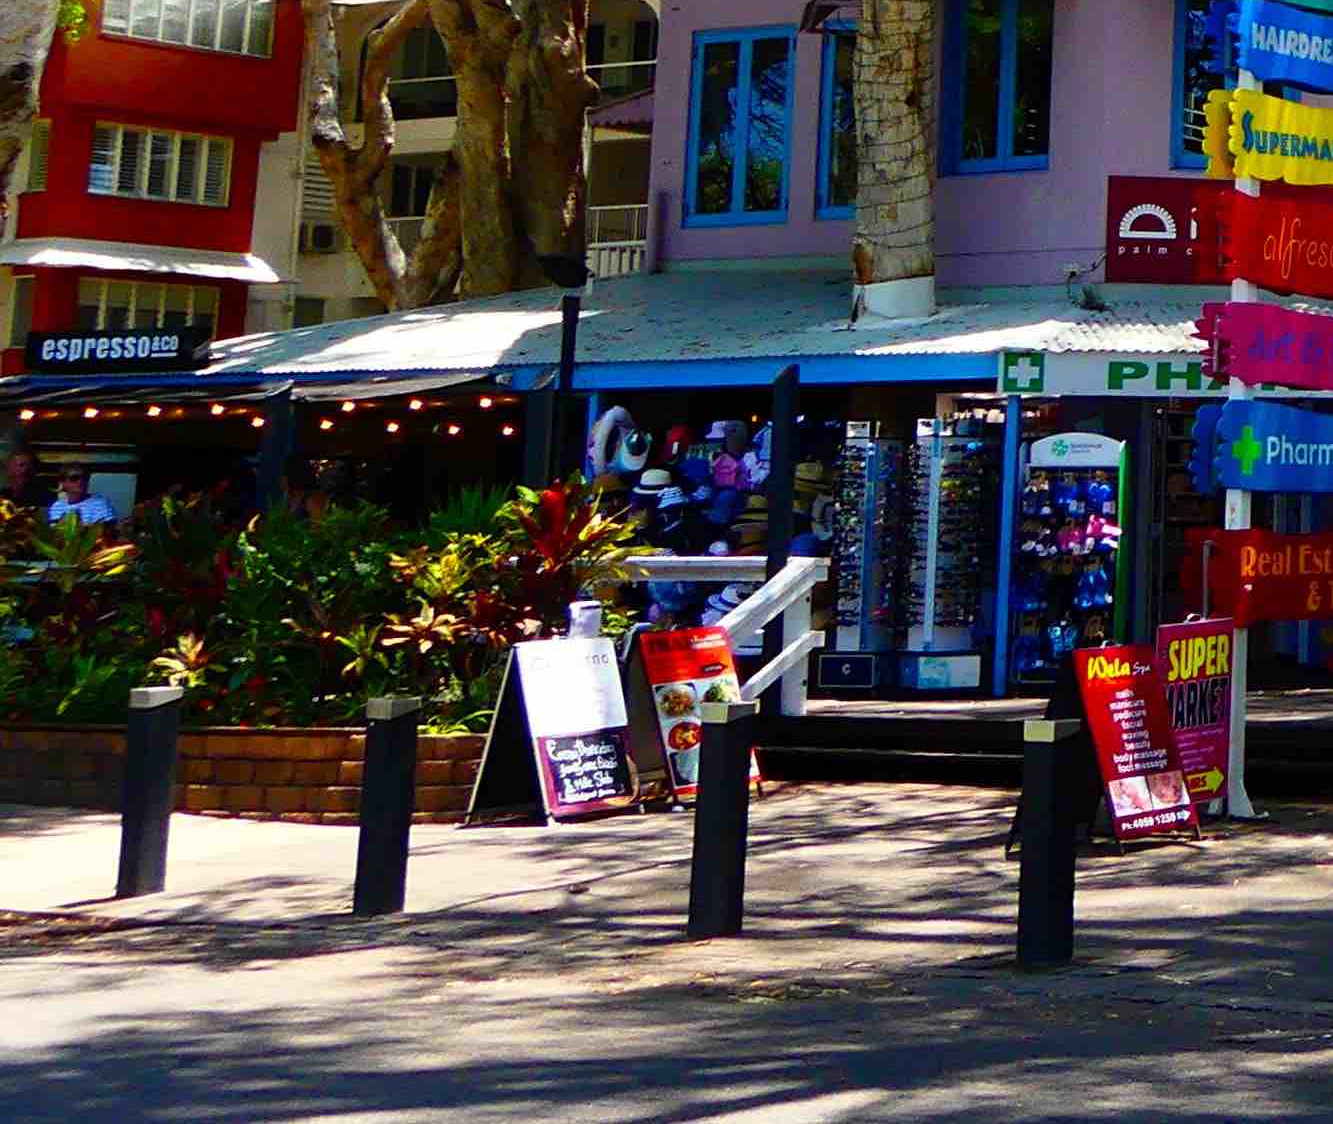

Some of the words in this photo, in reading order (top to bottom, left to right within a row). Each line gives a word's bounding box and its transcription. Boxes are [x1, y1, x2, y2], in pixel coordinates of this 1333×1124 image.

[1240, 544, 1292, 577] Real
[1306, 580, 1323, 612] &
[1168, 634, 1230, 682] SUPER
